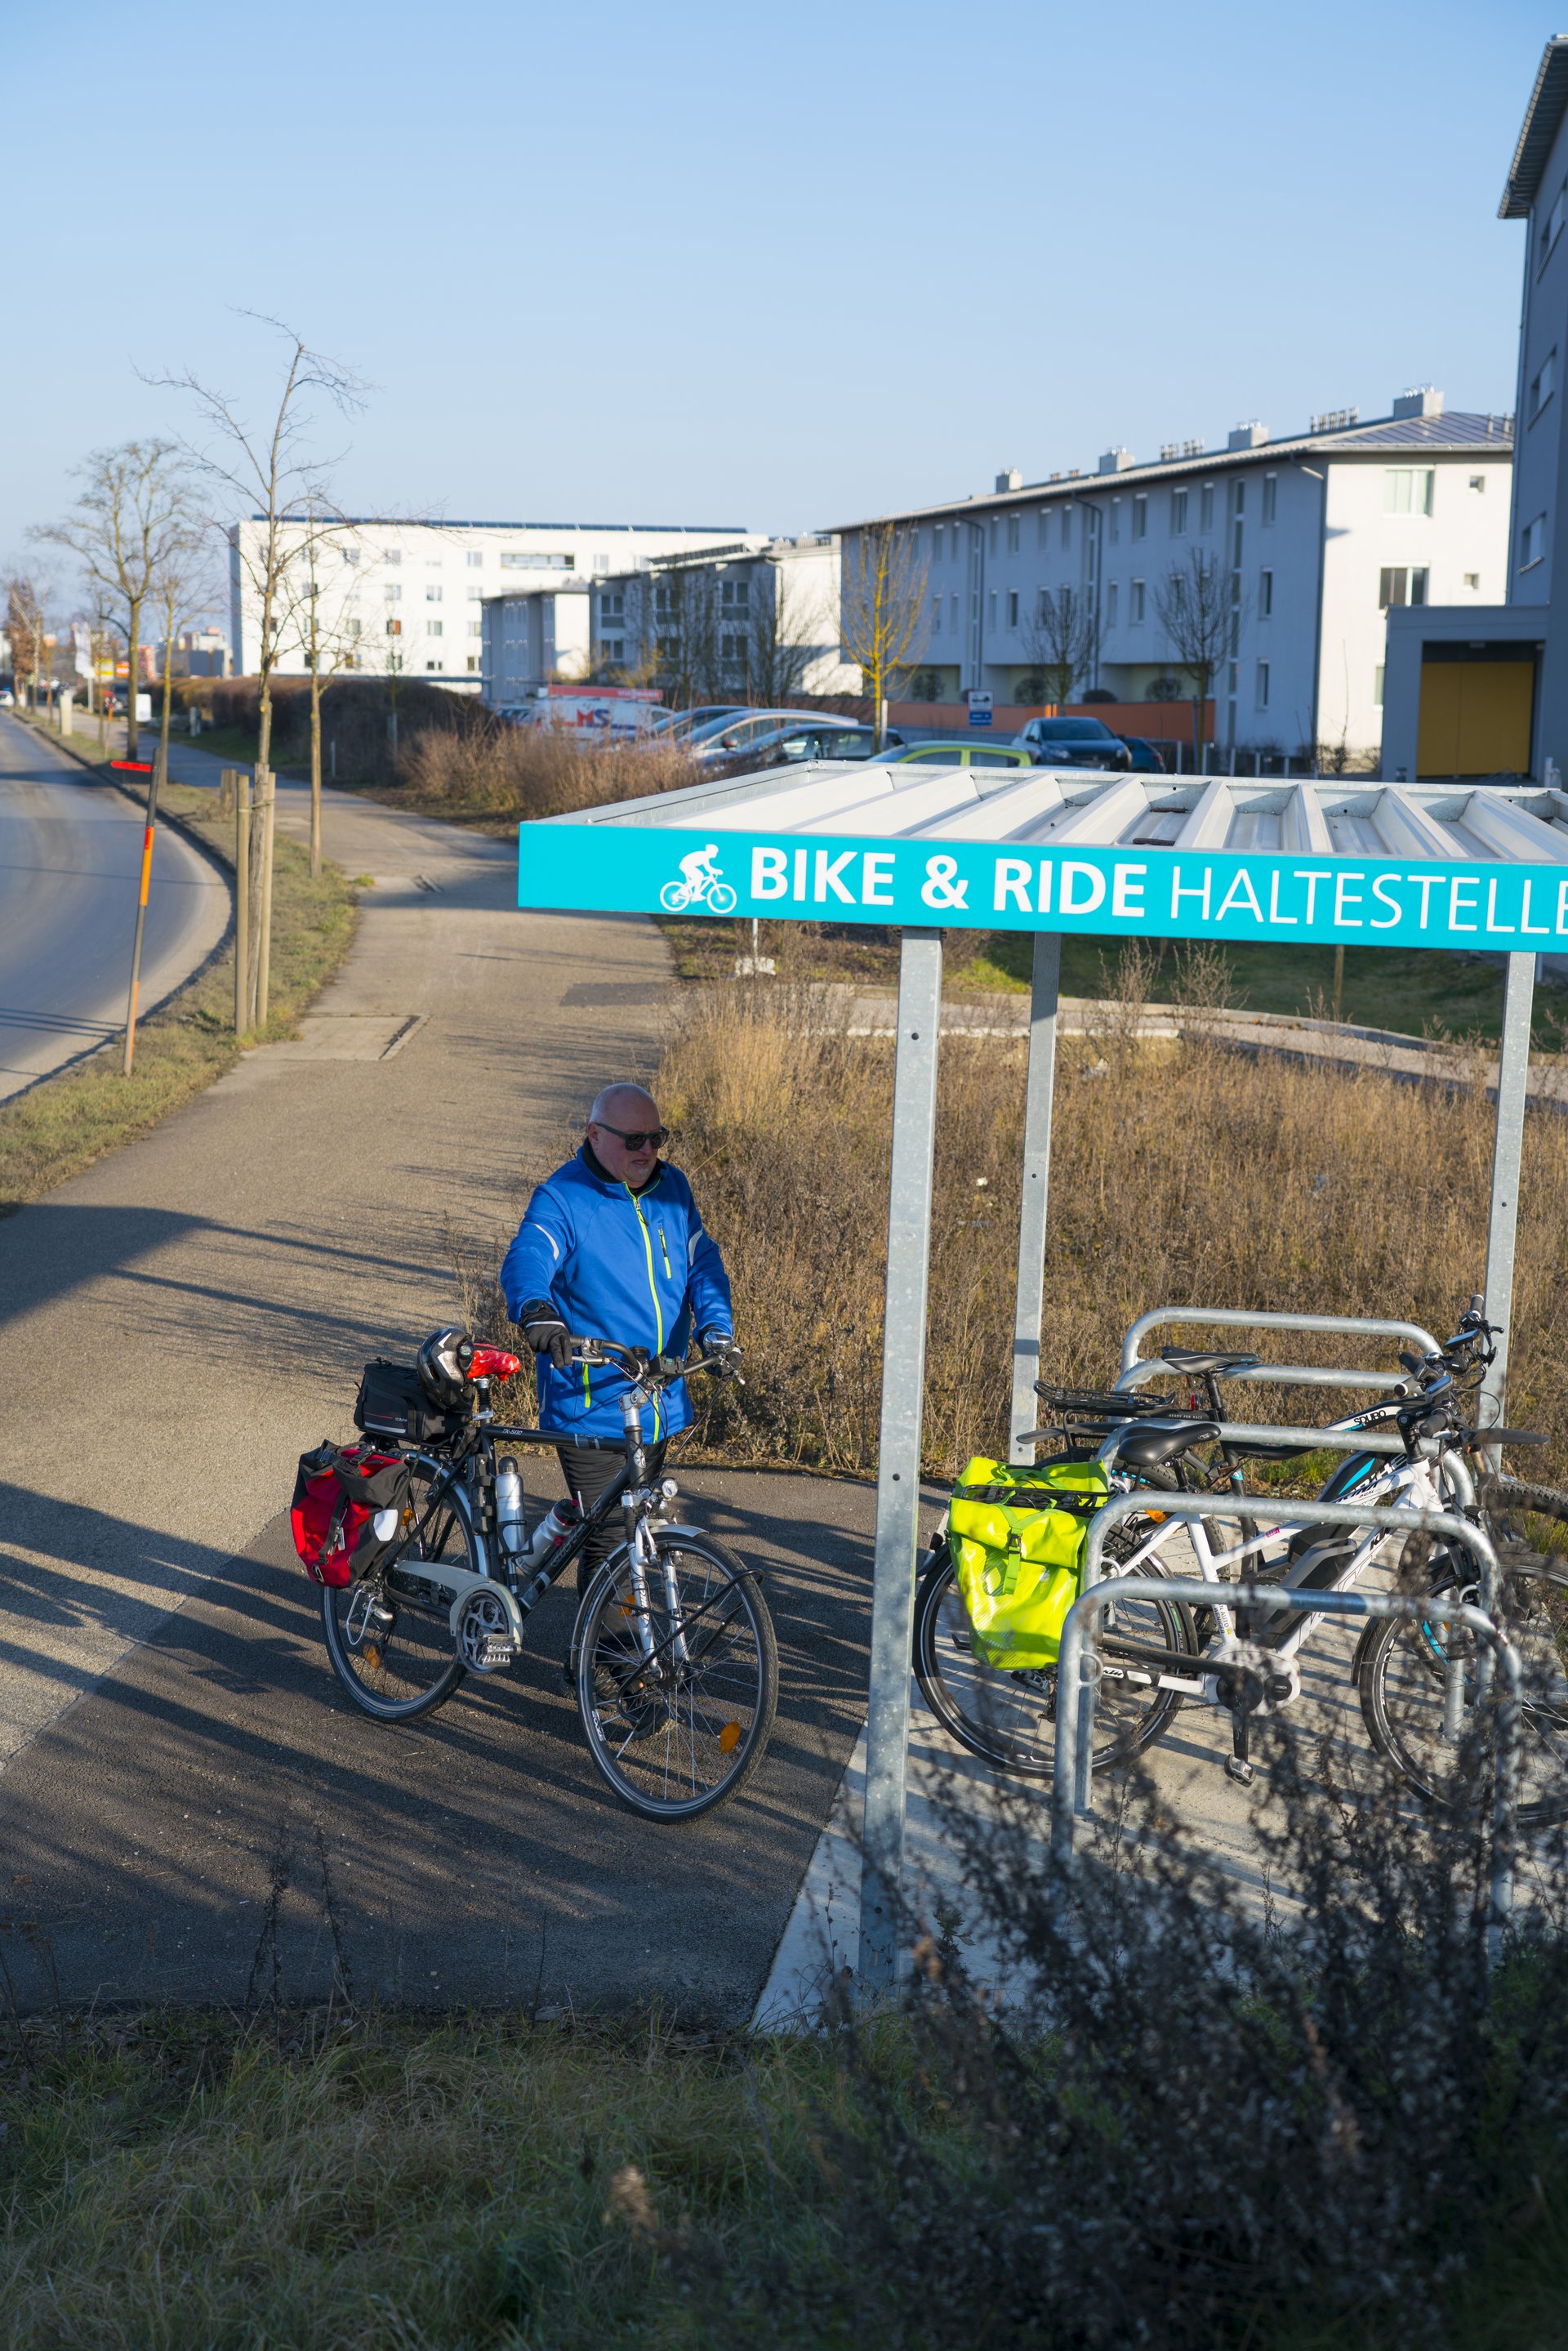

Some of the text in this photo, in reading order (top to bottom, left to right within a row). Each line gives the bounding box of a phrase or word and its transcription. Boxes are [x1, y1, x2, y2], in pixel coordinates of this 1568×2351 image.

[751, 847, 895, 905] BIKE
[921, 854, 969, 909] &
[994, 859, 1147, 917] RIDE
[1214, 1608, 1225, 1634] WENIGER
[1220, 1612, 1229, 1628] AUTO
